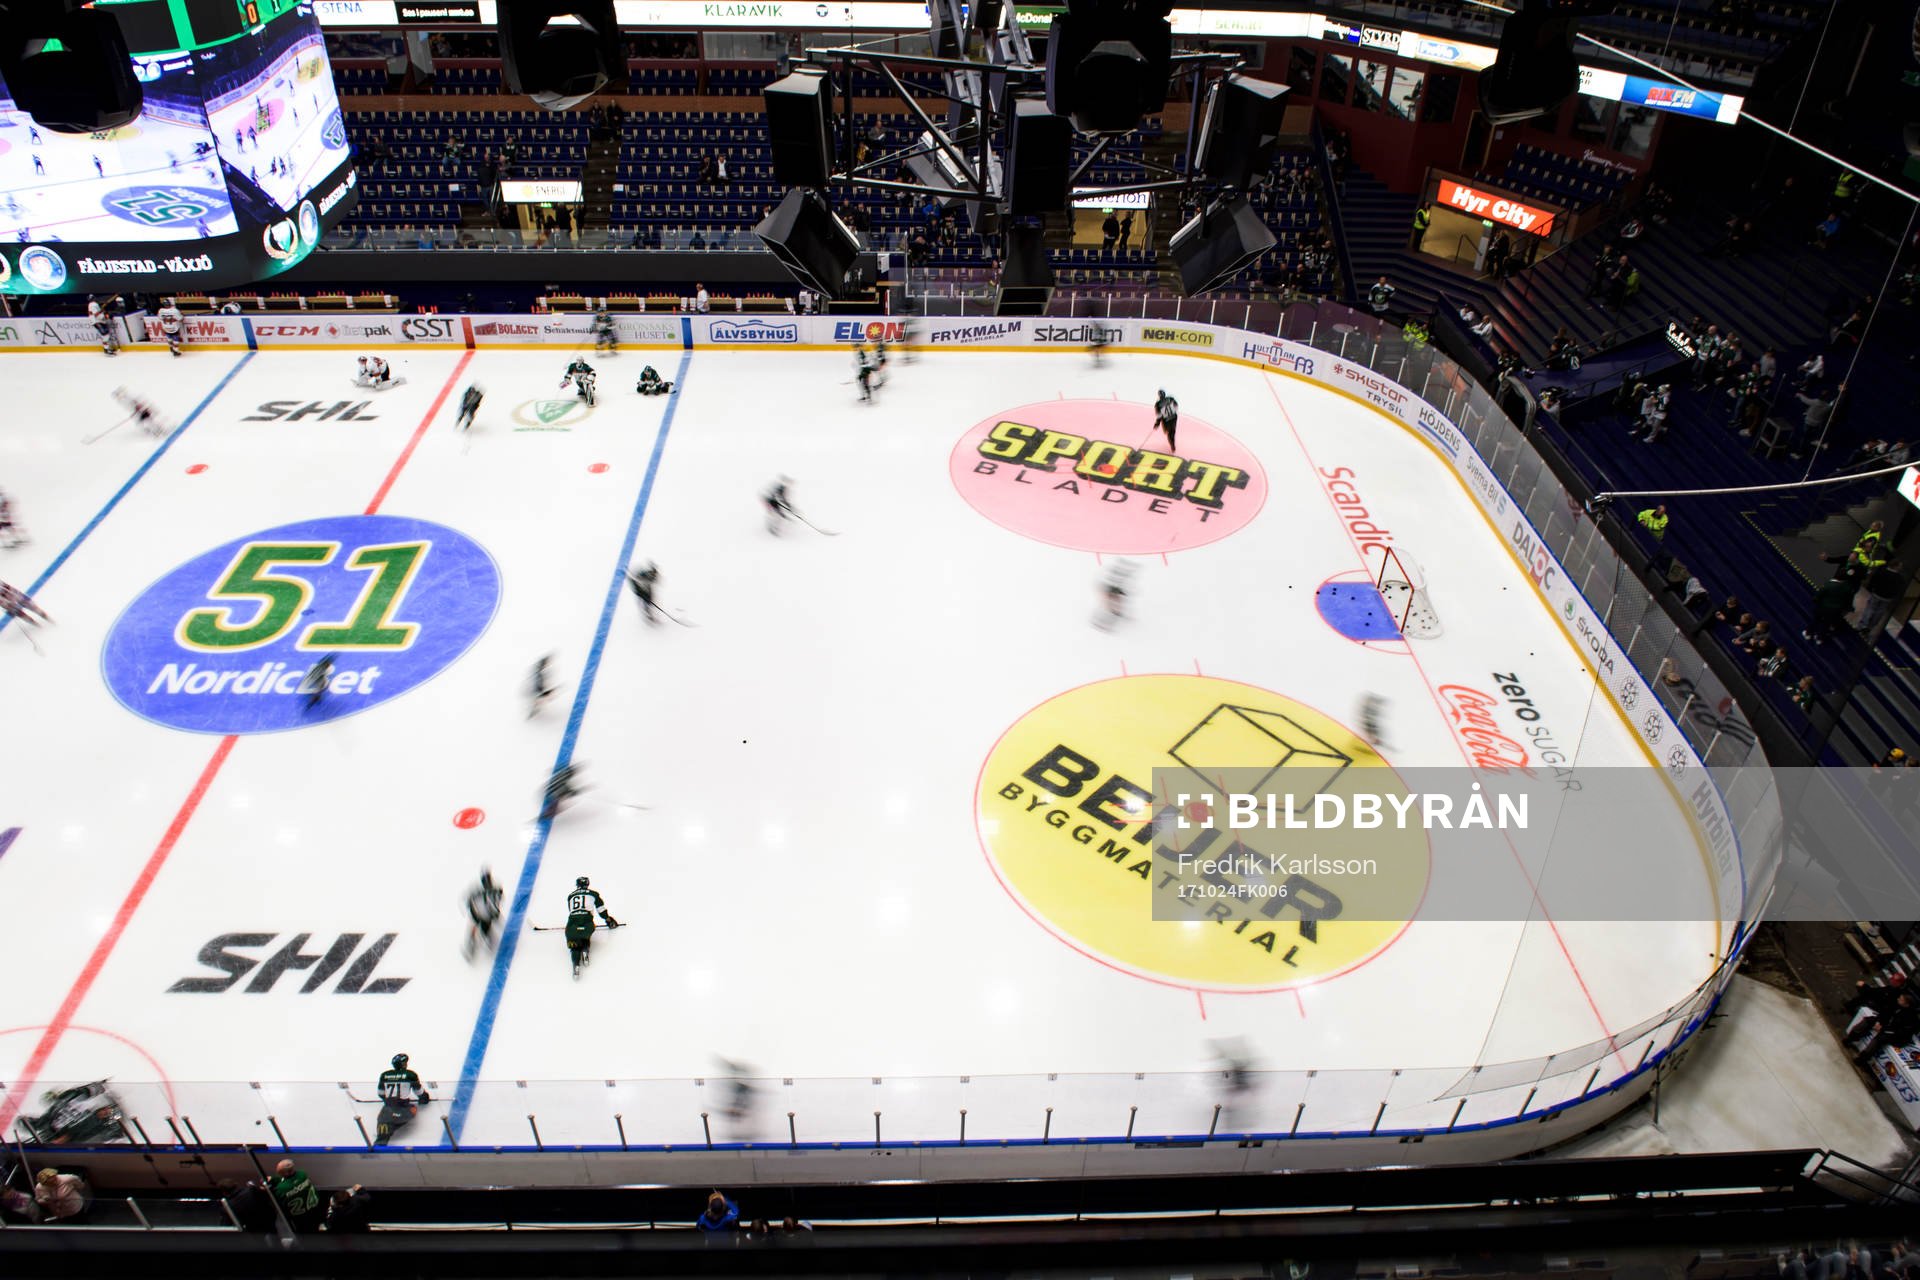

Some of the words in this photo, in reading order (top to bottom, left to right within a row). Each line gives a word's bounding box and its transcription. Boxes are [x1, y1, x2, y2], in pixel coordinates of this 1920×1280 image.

[322, 2, 363, 14] STENA
[704, 4, 783, 17] KLARAVIK
[1451, 186, 1490, 213] Hyr
[1492, 200, 1536, 230] City
[77, 257, 157, 274] FÄRJESTAD
[164, 254, 213, 273] VÄXJÖ
[255, 326, 320, 337] CCM
[714, 327, 795, 340] ÄLVSBYHUS
[833, 321, 906, 341] ELON
[930, 320, 1022, 343] FRYKMALM
[1034, 324, 1123, 342] stadium
[239, 400, 379, 422] SHL
[1366, 390, 1405, 418] TRYSIL
[1419, 406, 1461, 452] HÖJDENS
[977, 420, 1251, 510] SPORT
[972, 460, 1220, 523] BLADET
[1319, 466, 1394, 556] Scandic
[1511, 520, 1556, 591] DALOC
[174, 540, 433, 654] 51
[1576, 615, 1615, 676] ŠKODA
[1492, 671, 1541, 722] zero
[1525, 726, 1584, 792] SUGAR
[998, 781, 1300, 968] BYGGMATERIAL
[572, 895, 586, 910] 61
[162, 932, 414, 994] SHL
[287, 1184, 319, 1216] 24
